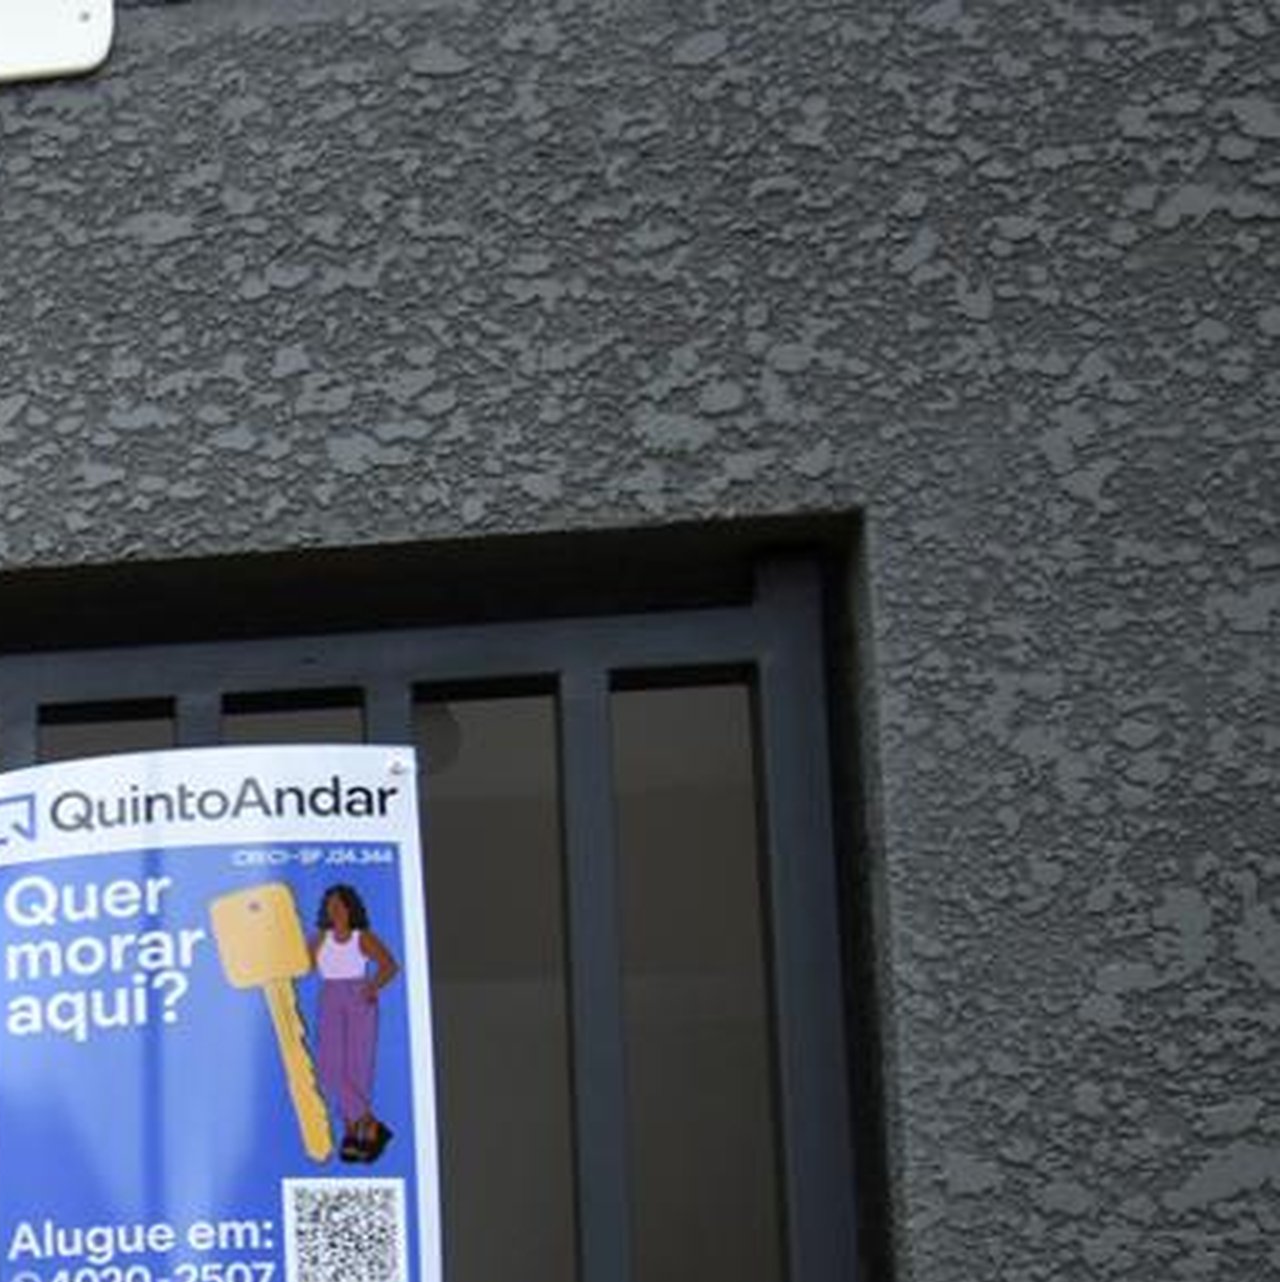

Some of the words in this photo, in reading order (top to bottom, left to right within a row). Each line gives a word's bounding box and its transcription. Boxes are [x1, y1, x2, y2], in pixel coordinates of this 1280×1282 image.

[49, 775, 400, 832] QuintoAndar
[4, 874, 173, 928] Quer
[5, 928, 205, 981] morar
[6, 970, 189, 1040] aqui?
[7, 1220, 176, 1266] Alugue
[187, 1216, 275, 1251] em:
